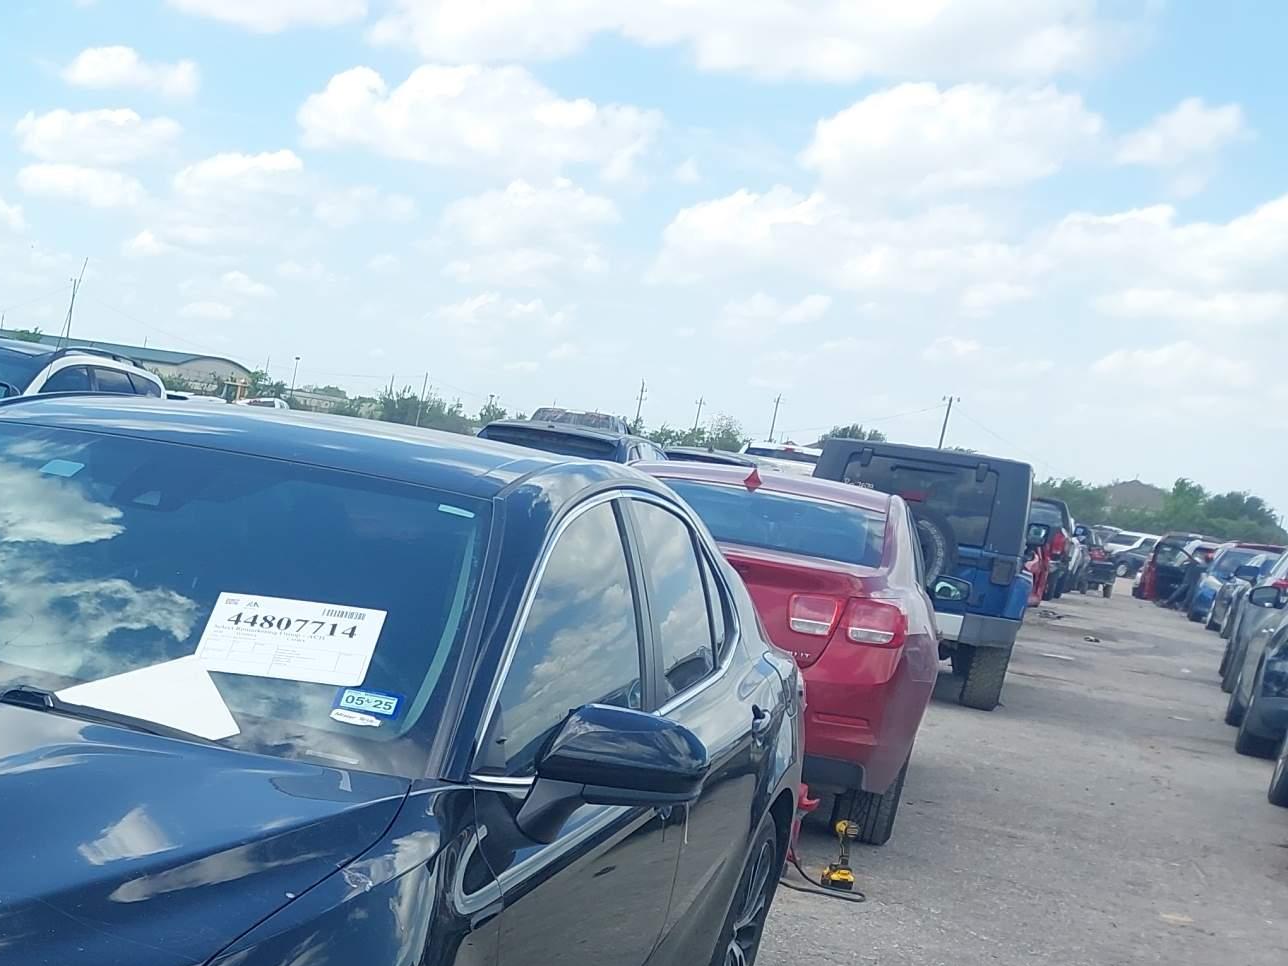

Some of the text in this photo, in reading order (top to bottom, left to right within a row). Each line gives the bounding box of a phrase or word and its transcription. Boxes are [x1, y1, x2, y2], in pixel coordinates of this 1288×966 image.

[227, 612, 358, 638] 44807714
[345, 694, 366, 706] 05
[372, 699, 394, 711] 25
